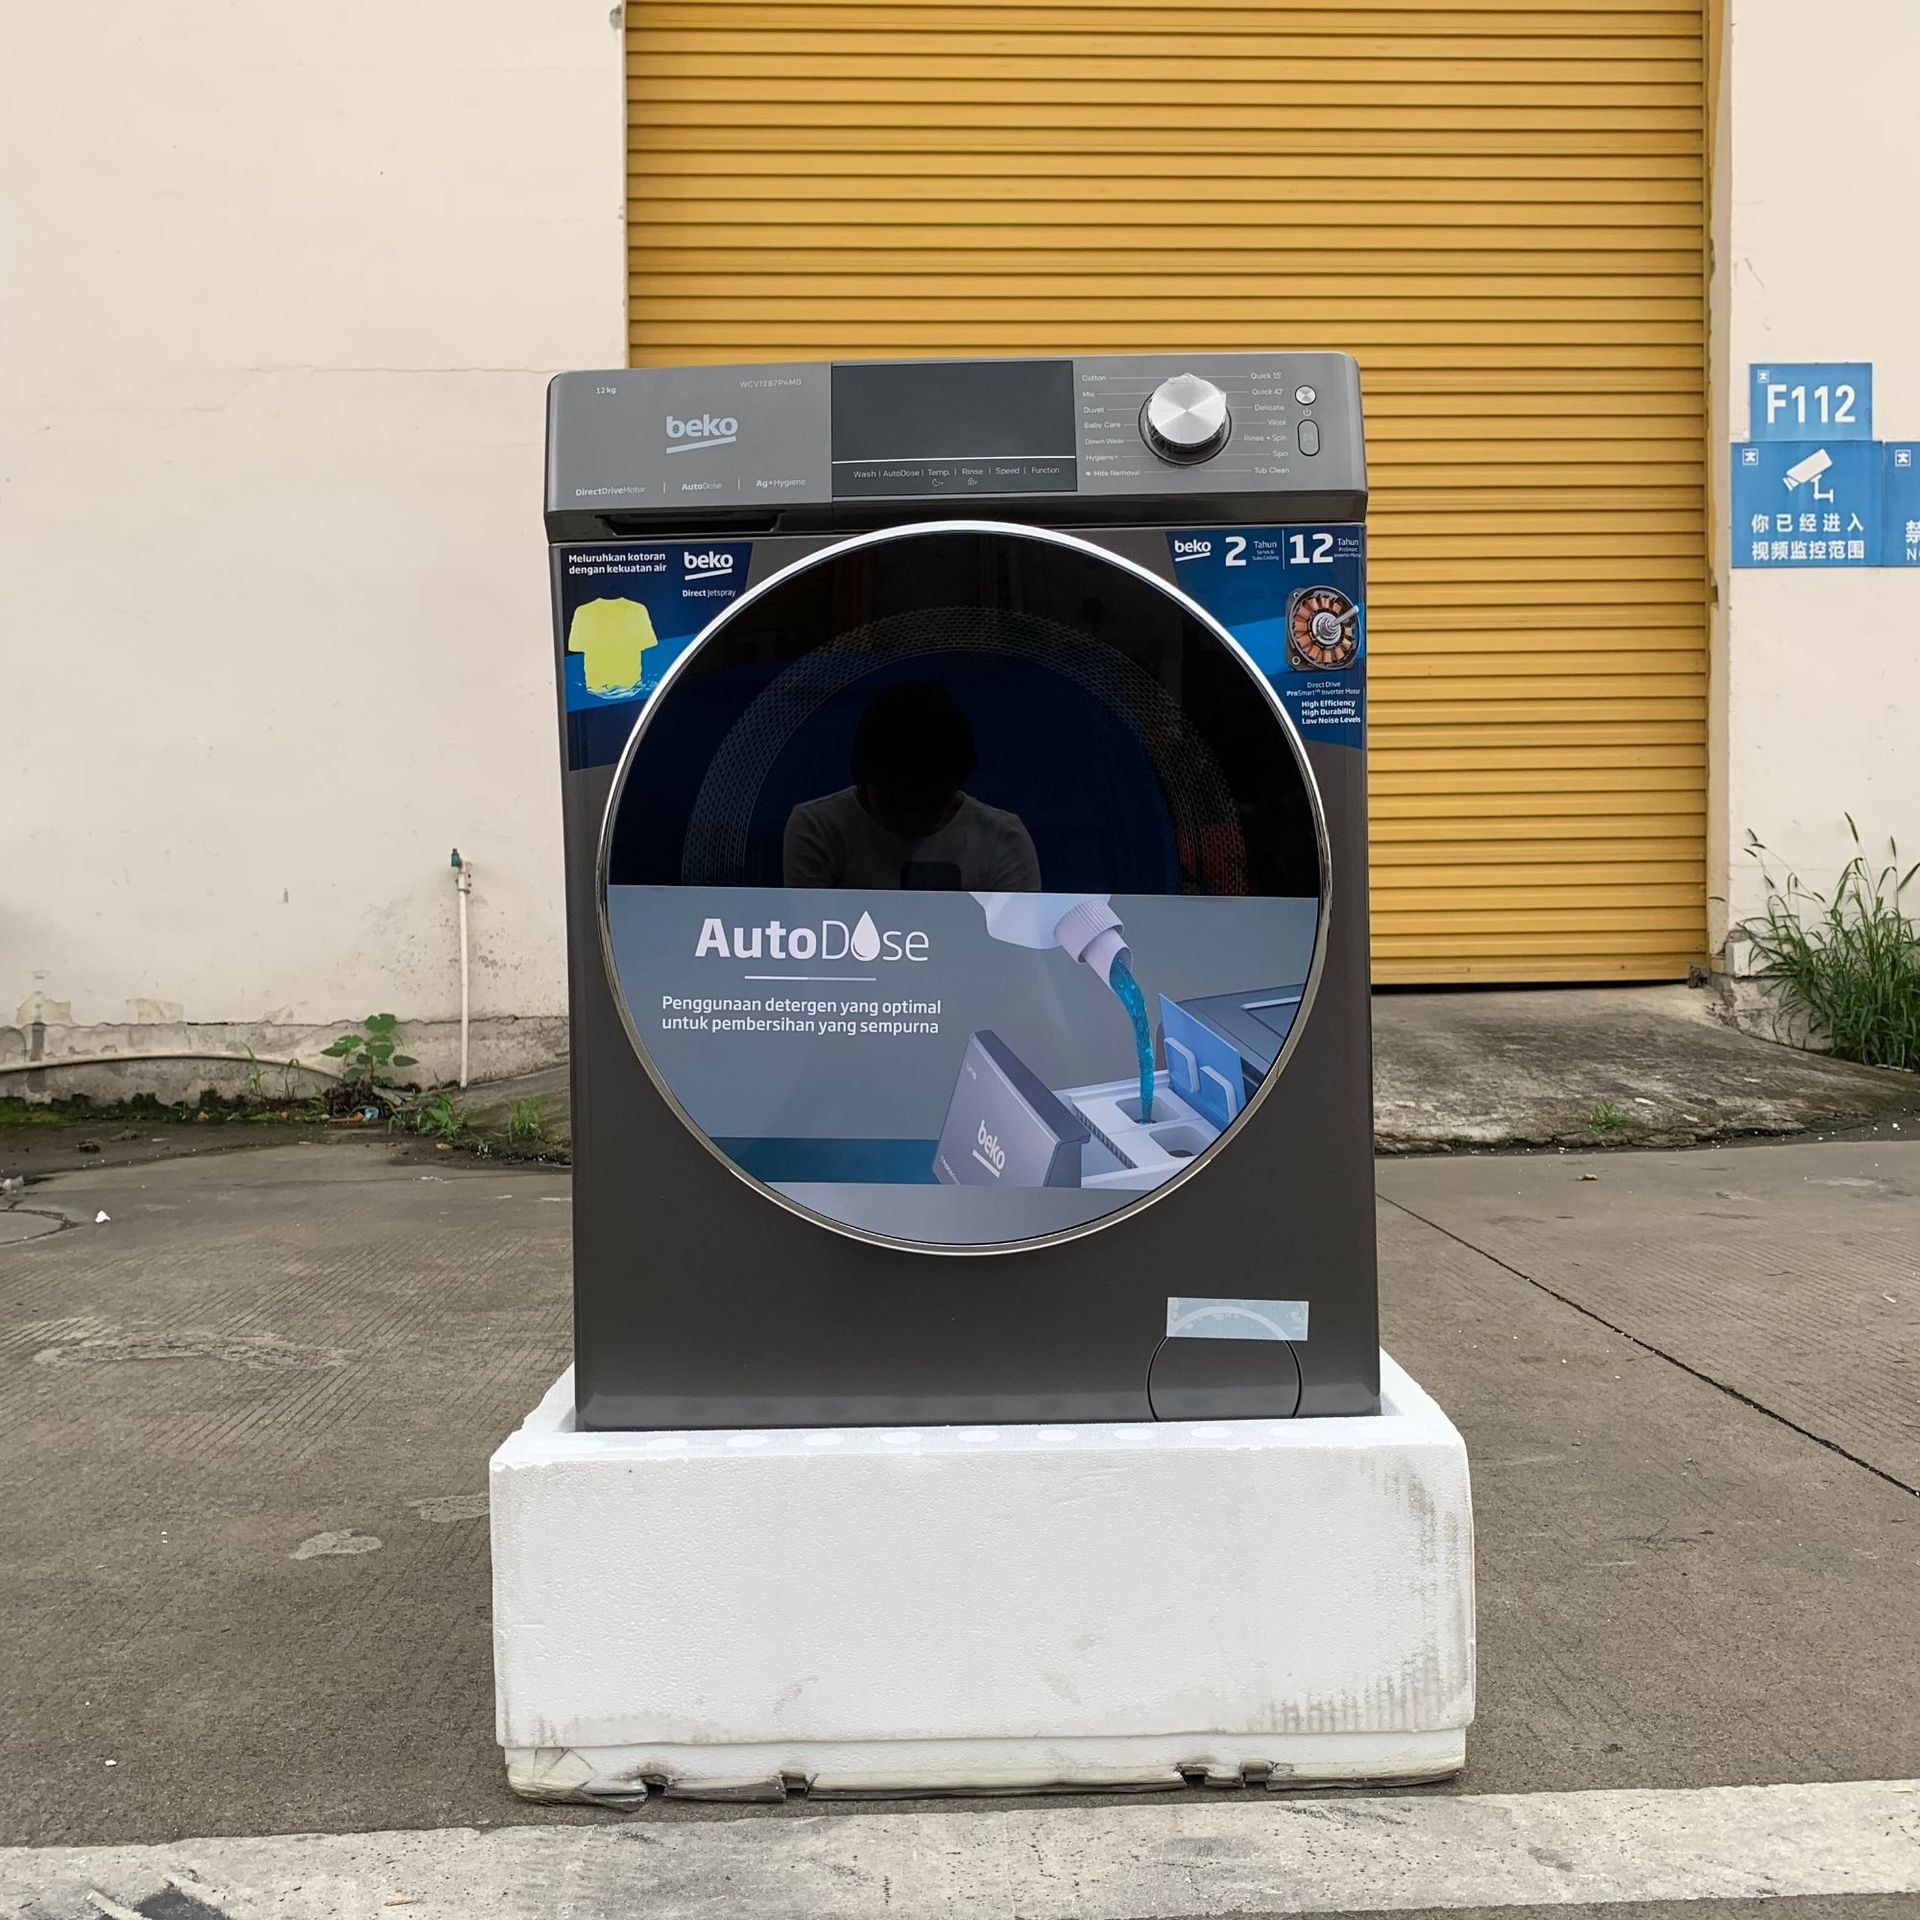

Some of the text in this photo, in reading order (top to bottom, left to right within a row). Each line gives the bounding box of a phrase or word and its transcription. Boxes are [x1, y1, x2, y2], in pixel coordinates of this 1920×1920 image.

[1082, 374, 1106, 382] Cotton
[1254, 404, 1285, 412] Delicate
[1767, 384, 1856, 424] F112
[1083, 406, 1105, 414] Duvet
[666, 414, 738, 438] beko
[1084, 421, 1101, 430] Baby
[1085, 438, 1105, 446] Down
[1271, 433, 1288, 443] Spin
[1272, 449, 1289, 458] Spin
[853, 470, 877, 478] Wash
[882, 469, 921, 478] AutoDose
[961, 468, 983, 476] Rinse
[995, 466, 1020, 476] Speed
[1031, 466, 1060, 475] Function
[1254, 466, 1290, 475] Tub Clean
[1751, 513, 1864, 533] 你已经进入
[1174, 539, 1211, 553] beko
[1254, 540, 1277, 549] Tahun
[1337, 538, 1359, 546] Tahun
[1225, 536, 1247, 567] 2
[1289, 533, 1334, 564] 12
[1751, 540, 1864, 561] 视频监控范围
[568, 552, 666, 563] Meluruhkan kotoran
[683, 551, 733, 569] beko
[569, 563, 667, 576] dengan kekuatan air
[682, 589, 706, 597] Direct
[1320, 699, 1356, 707] Efficiency
[1320, 708, 1356, 716] Durability
[662, 995, 941, 1017] Penggunaan detergen yang optimal
[662, 1015, 939, 1036] untuk pembersihan yang sempurna
[977, 1118, 1006, 1170] beko
